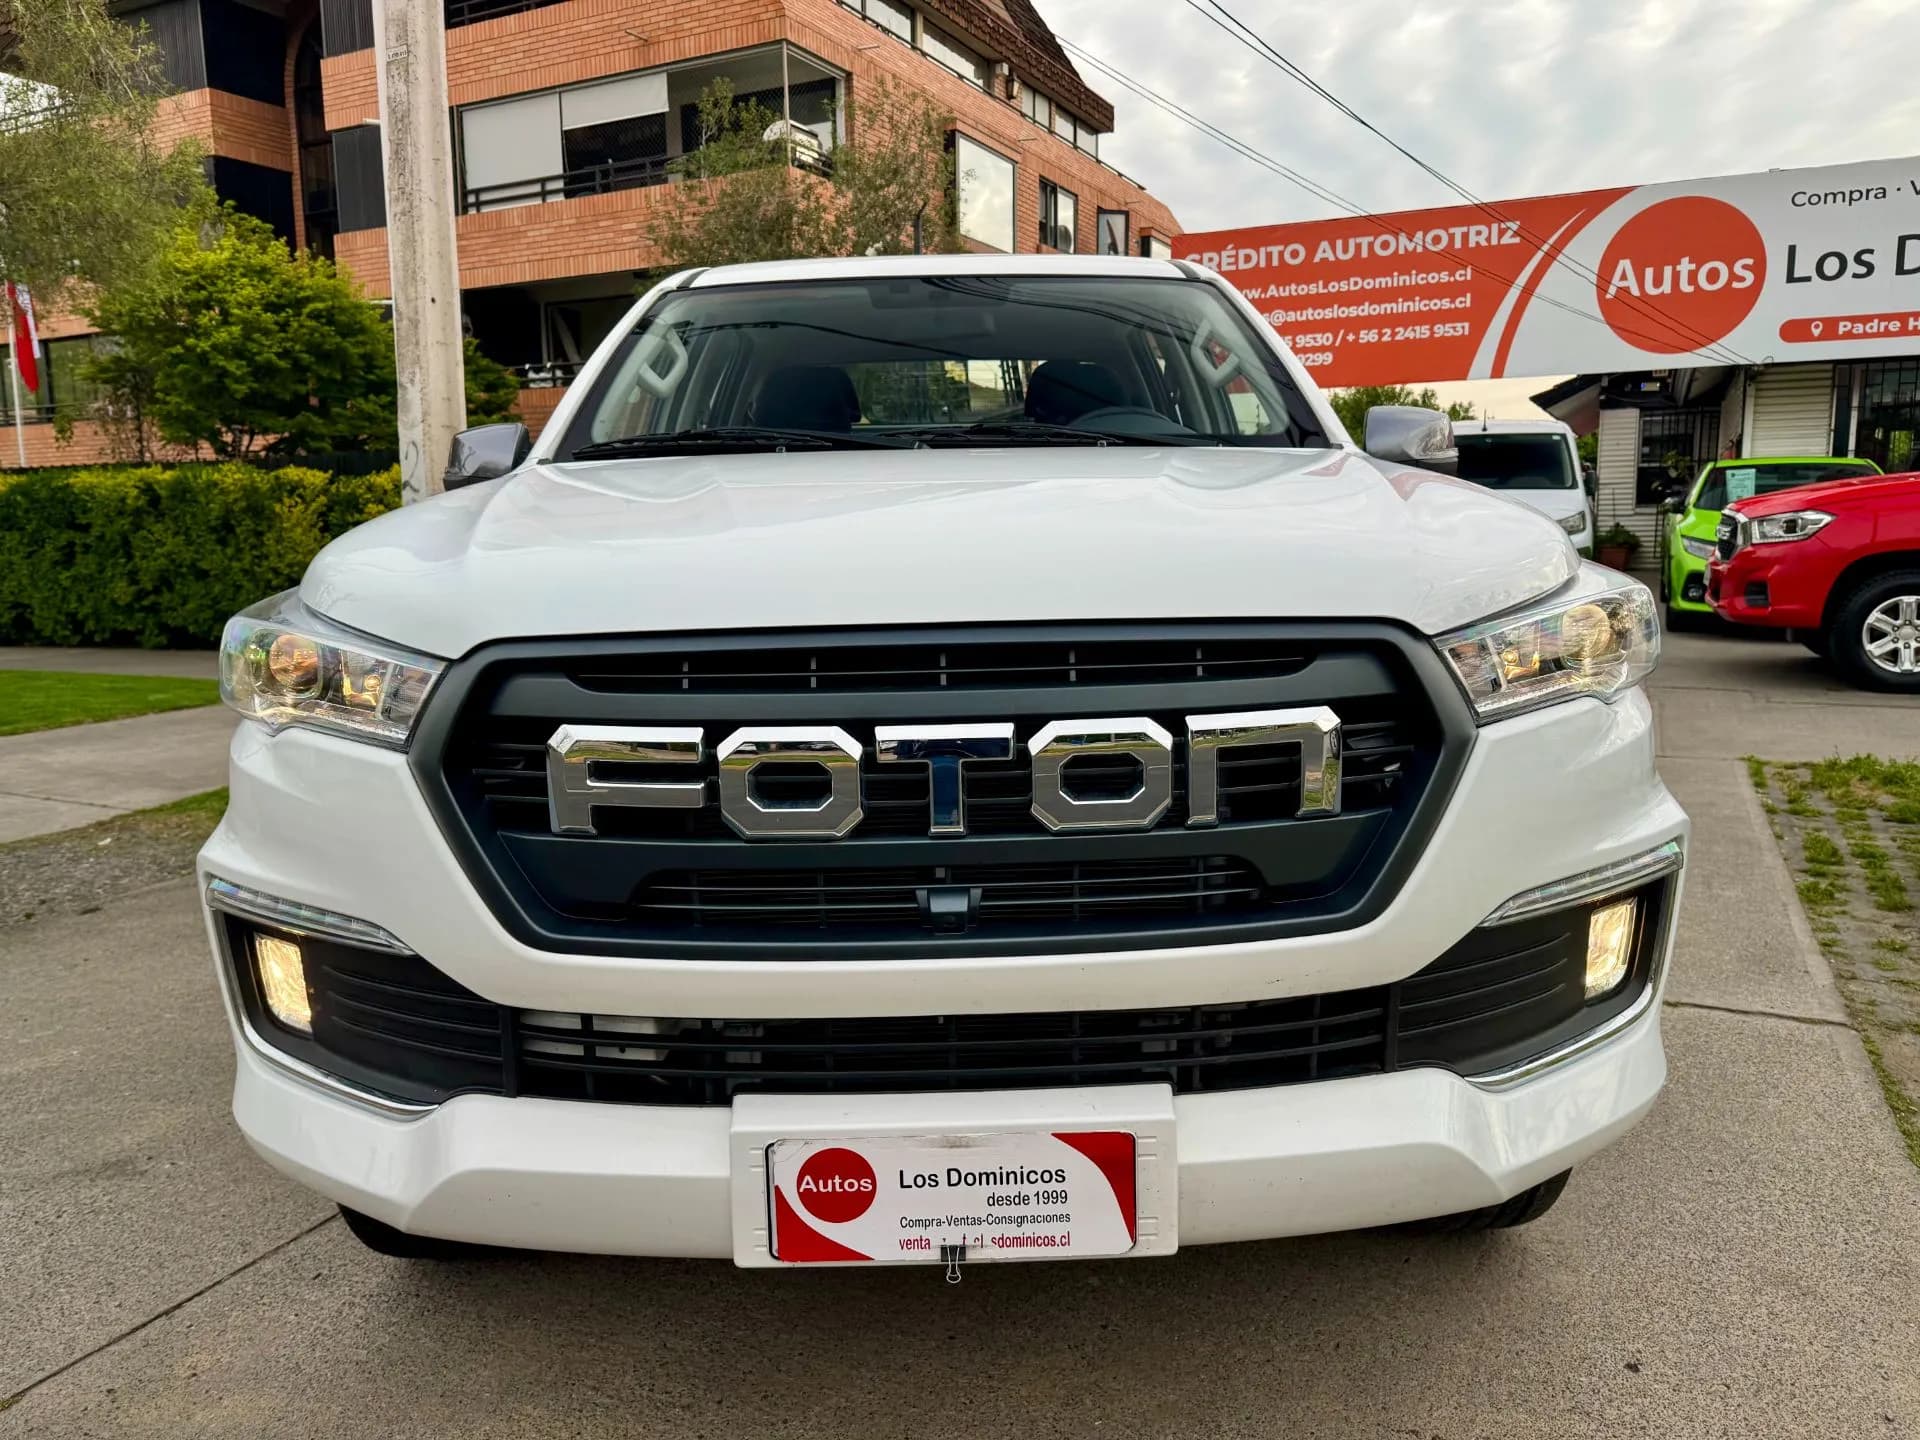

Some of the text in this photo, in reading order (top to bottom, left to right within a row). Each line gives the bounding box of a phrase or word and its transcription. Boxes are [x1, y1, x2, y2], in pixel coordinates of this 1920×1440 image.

[1791, 186, 1887, 207] Compra
[1312, 221, 1521, 264] AUTOMOTRIZ
[1786, 244, 1876, 284] Los
[1604, 256, 1755, 300] Autos
[1295, 332, 1333, 348] 9530
[1358, 329, 1379, 344] 56
[1381, 327, 1392, 342] 2
[1394, 325, 1431, 341] 2415
[1433, 322, 1470, 338] 9531
[1838, 318, 1901, 335] Padre
[547, 706, 1343, 841] FOTON
[799, 1175, 873, 1193] Autos
[899, 1166, 1066, 1189] Los Dominicos
[987, 1189, 1068, 1208] desde 1999
[899, 1212, 1071, 1230] Compra-Ventas-Consignaciones
